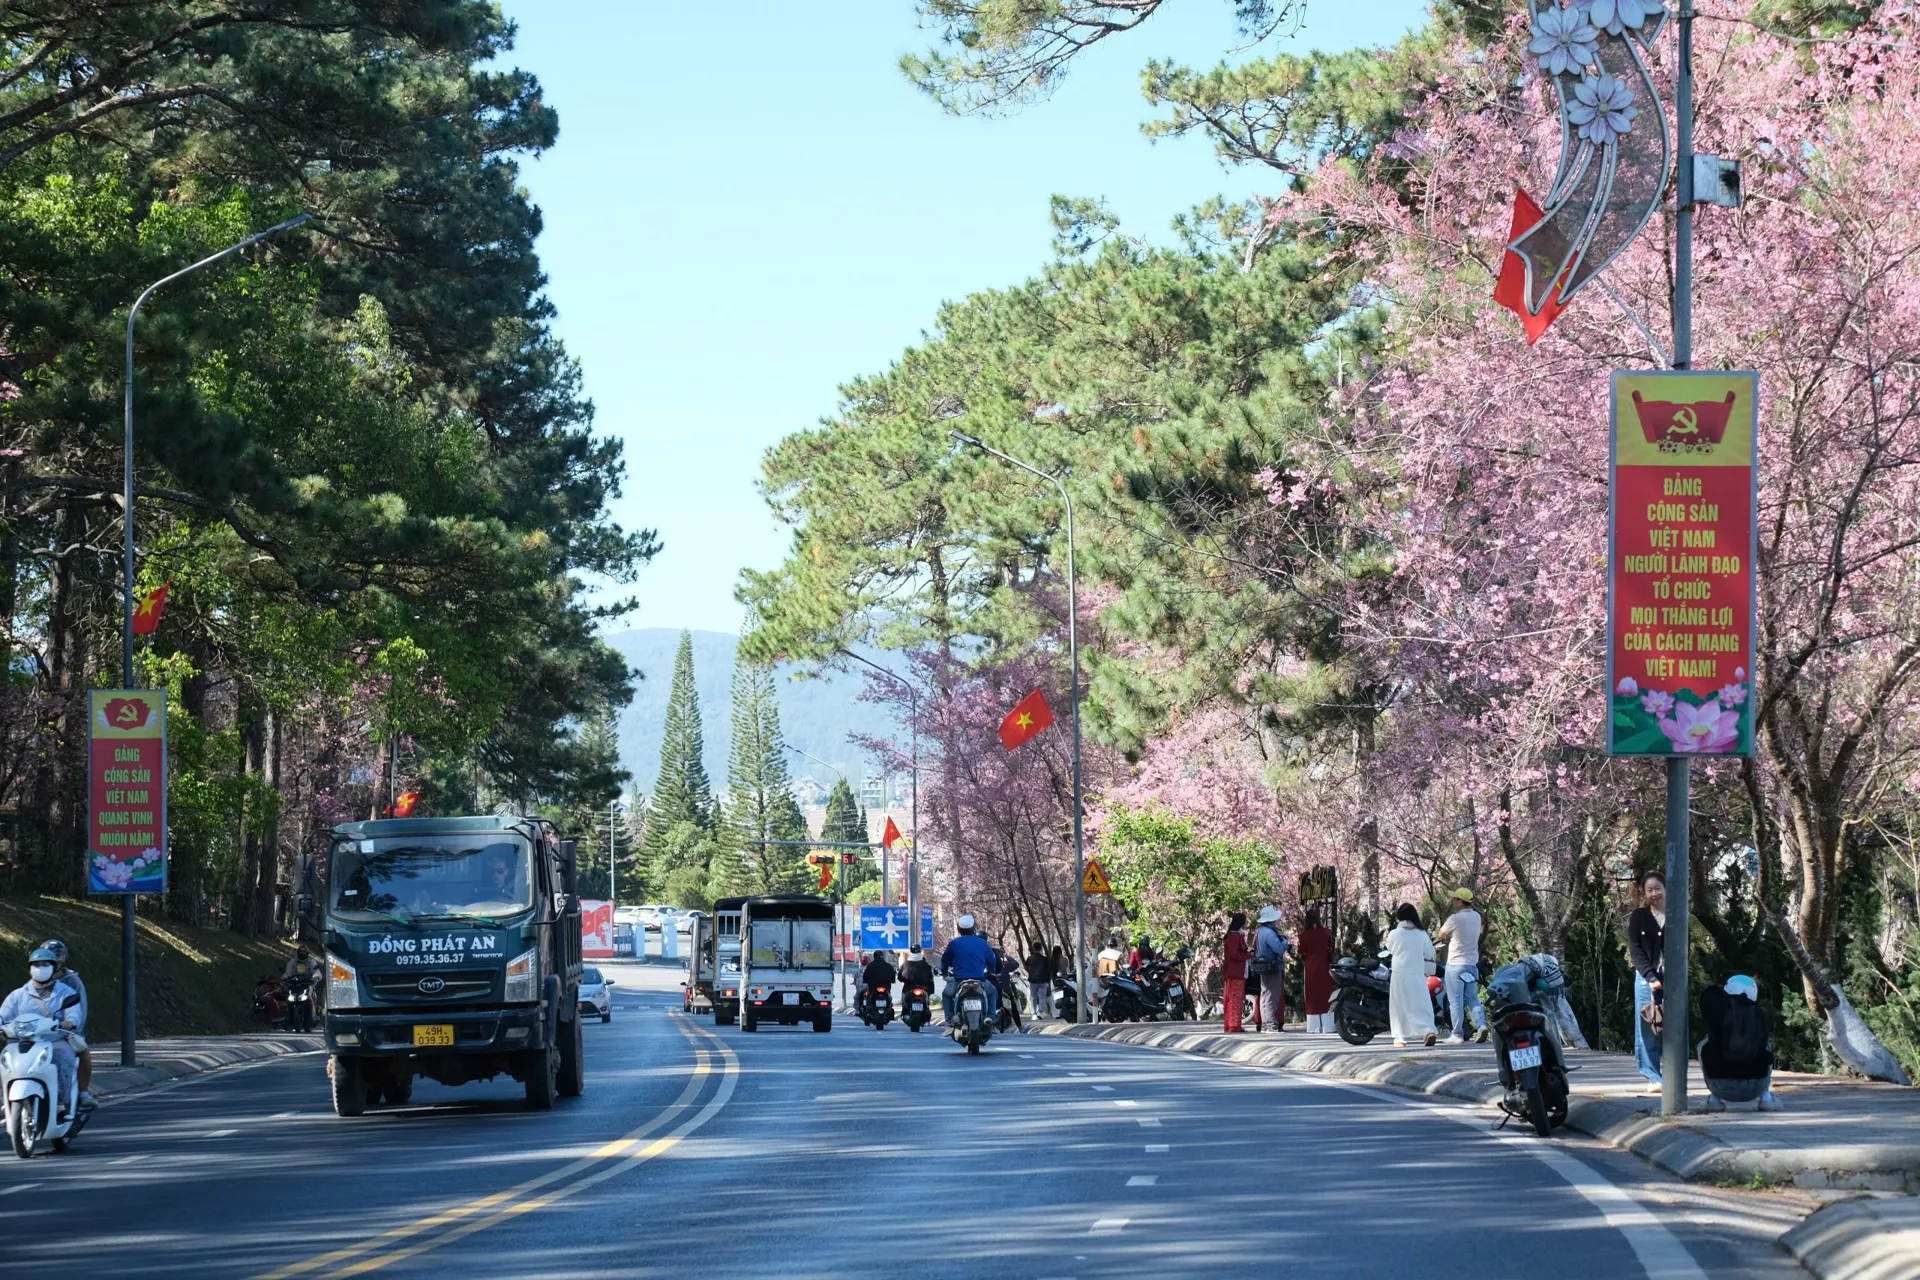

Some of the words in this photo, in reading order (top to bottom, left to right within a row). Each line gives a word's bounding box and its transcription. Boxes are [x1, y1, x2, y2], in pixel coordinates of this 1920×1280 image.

[1663, 472, 1703, 496] ĐẢNG
[1647, 500, 1686, 525] CỘNG
[1689, 498, 1719, 522] SẢN
[1649, 526, 1679, 551] VIỆT
[1682, 529, 1715, 548] NAM
[1624, 551, 1668, 574] NGƯỜI
[1671, 552, 1708, 574] LÃNH
[1711, 555, 1740, 579] ĐẠO
[1652, 575, 1671, 600] TỔ
[1673, 578, 1712, 600] CHỨC
[1630, 607, 1658, 629] MỌI
[1661, 601, 1707, 626] THẮNG
[1711, 606, 1733, 629] LỢI
[1623, 627, 1652, 651] CỦA
[1655, 629, 1694, 652] CÁCH
[1697, 633, 1739, 656] MẠNG
[1645, 655, 1677, 680] VIỆT
[1678, 659, 1717, 678] NAM!
[114, 744, 140, 762] ĐẢNG
[104, 766, 129, 786] CỘNG
[131, 764, 151, 783] SẢN
[106, 788, 126, 807] VIỆT
[127, 790, 149, 804] NAM
[99, 811, 130, 825] QUANG
[131, 811, 153, 825] VINH
[100, 830, 128, 846] MUÔN
[129, 830, 154, 846] NĂM!
[368, 934, 417, 954] ĐỒNG
[420, 933, 467, 952] PHÁT
[470, 935, 496, 950] AN
[396, 953, 465, 965] 0979.35.36.37
[421, 981, 441, 989] TMT
[425, 1026, 443, 1035] 49H
